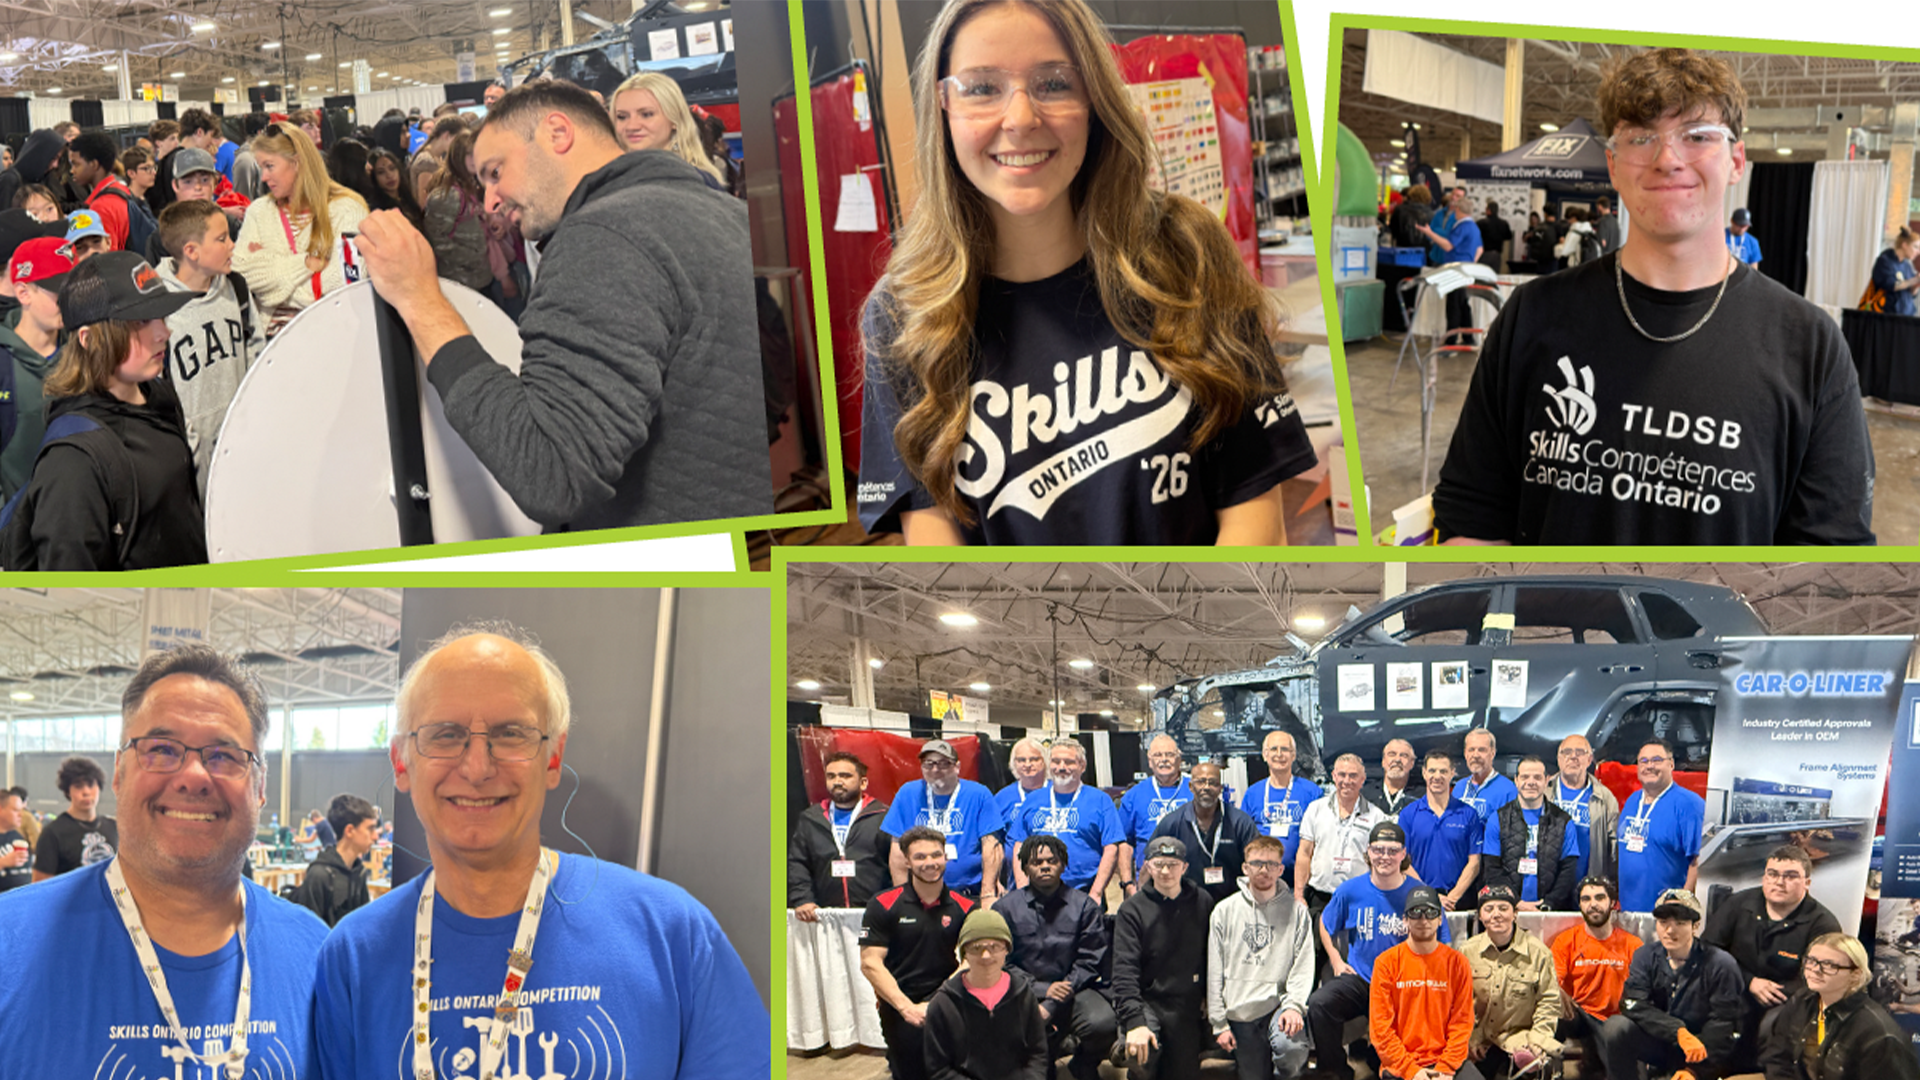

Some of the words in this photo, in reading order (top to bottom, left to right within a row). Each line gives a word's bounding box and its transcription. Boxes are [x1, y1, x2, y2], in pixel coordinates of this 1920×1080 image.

[1536, 138, 1579, 152] FIX
[1490, 165, 1583, 179] fixnetwork.com
[173, 318, 242, 382] GAP
[953, 345, 1170, 499] Skills
[1621, 403, 1742, 449] TLDSB
[1028, 439, 1110, 499] ONTARIO
[1529, 430, 1581, 464] Skills
[1582, 439, 1756, 493] Compétences
[1523, 457, 1604, 496] Canada
[1611, 473, 1722, 515] Ontario
[1742, 718, 1781, 729] Industry
[1782, 718, 1822, 728] Certified
[1823, 718, 1872, 729] Approvals
[1771, 731, 1802, 741] Leader
[1815, 732, 1840, 741] OEM
[1799, 763, 1829, 772] Frame
[1830, 763, 1877, 773] Alignment
[1837, 771, 1876, 781] Systems
[430, 996, 450, 1012] ILLS
[453, 993, 501, 1010] ONTARI
[518, 985, 600, 1006] OMPETITION
[109, 1024, 149, 1040] SKILLS
[152, 1024, 201, 1040] ONTRIO
[204, 1020, 277, 1039] COMPITION
